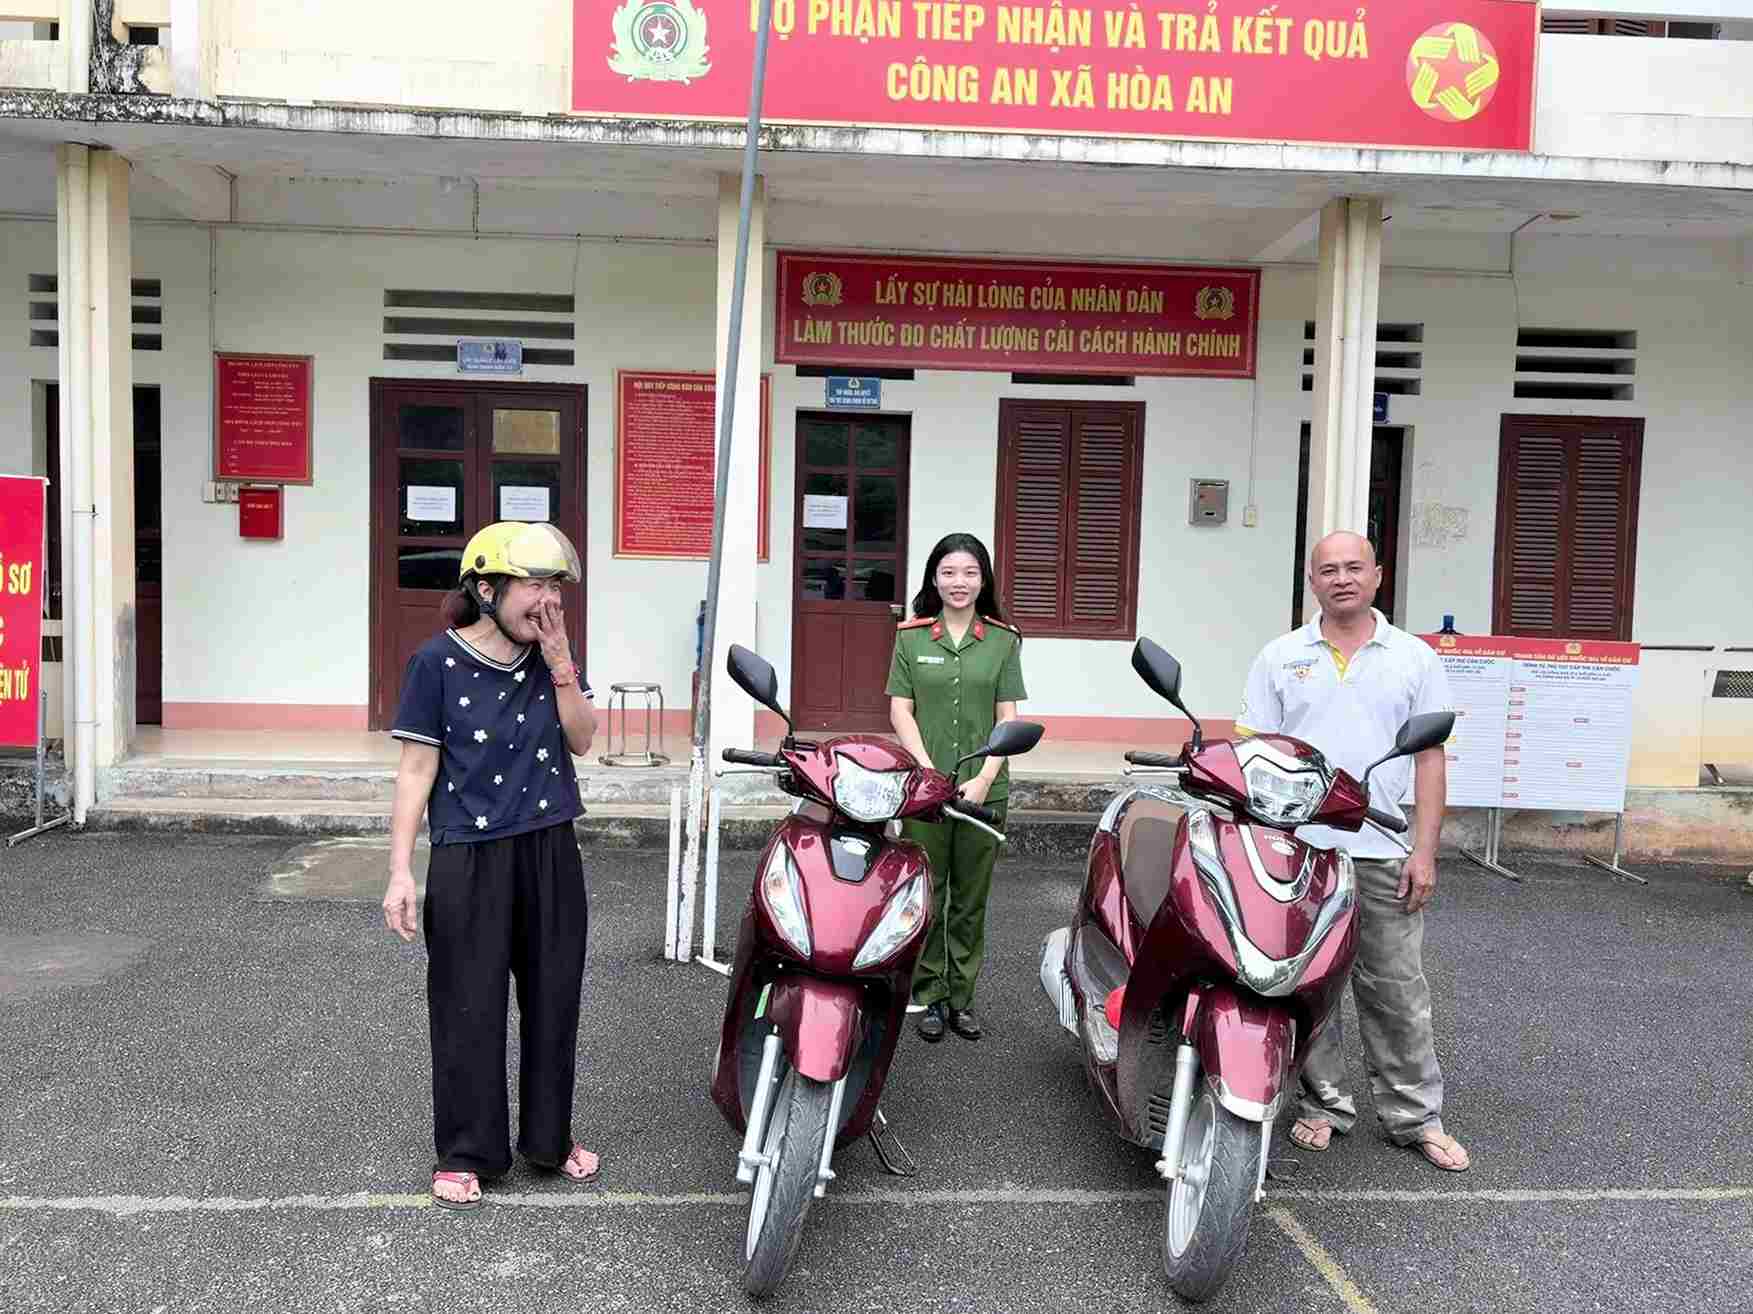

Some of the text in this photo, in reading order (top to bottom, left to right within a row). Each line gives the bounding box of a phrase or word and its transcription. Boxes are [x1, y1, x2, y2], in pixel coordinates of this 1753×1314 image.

[807, 0, 900, 44] PHẬN
[915, 0, 985, 42] TIẾP
[997, 0, 1092, 53] NHẬN
[1104, 8, 1147, 50] VÀ
[1157, 0, 1221, 53] TRẢ
[1232, 4, 1294, 56] KẾT
[1303, 9, 1369, 59] QUẢ
[886, 55, 1233, 115] CÔNG AN XÃ HÒA AN
[875, 273, 1163, 313] LẤY SỰ HÀI LÒNG CỦA NHÂN DÂN
[793, 314, 1241, 358] LÀM THƯỚC ĐO CHẤT LƯỢNG CẢI CÁCH HÀNH CHÍNH
[8, 561, 32, 595] SƠ
